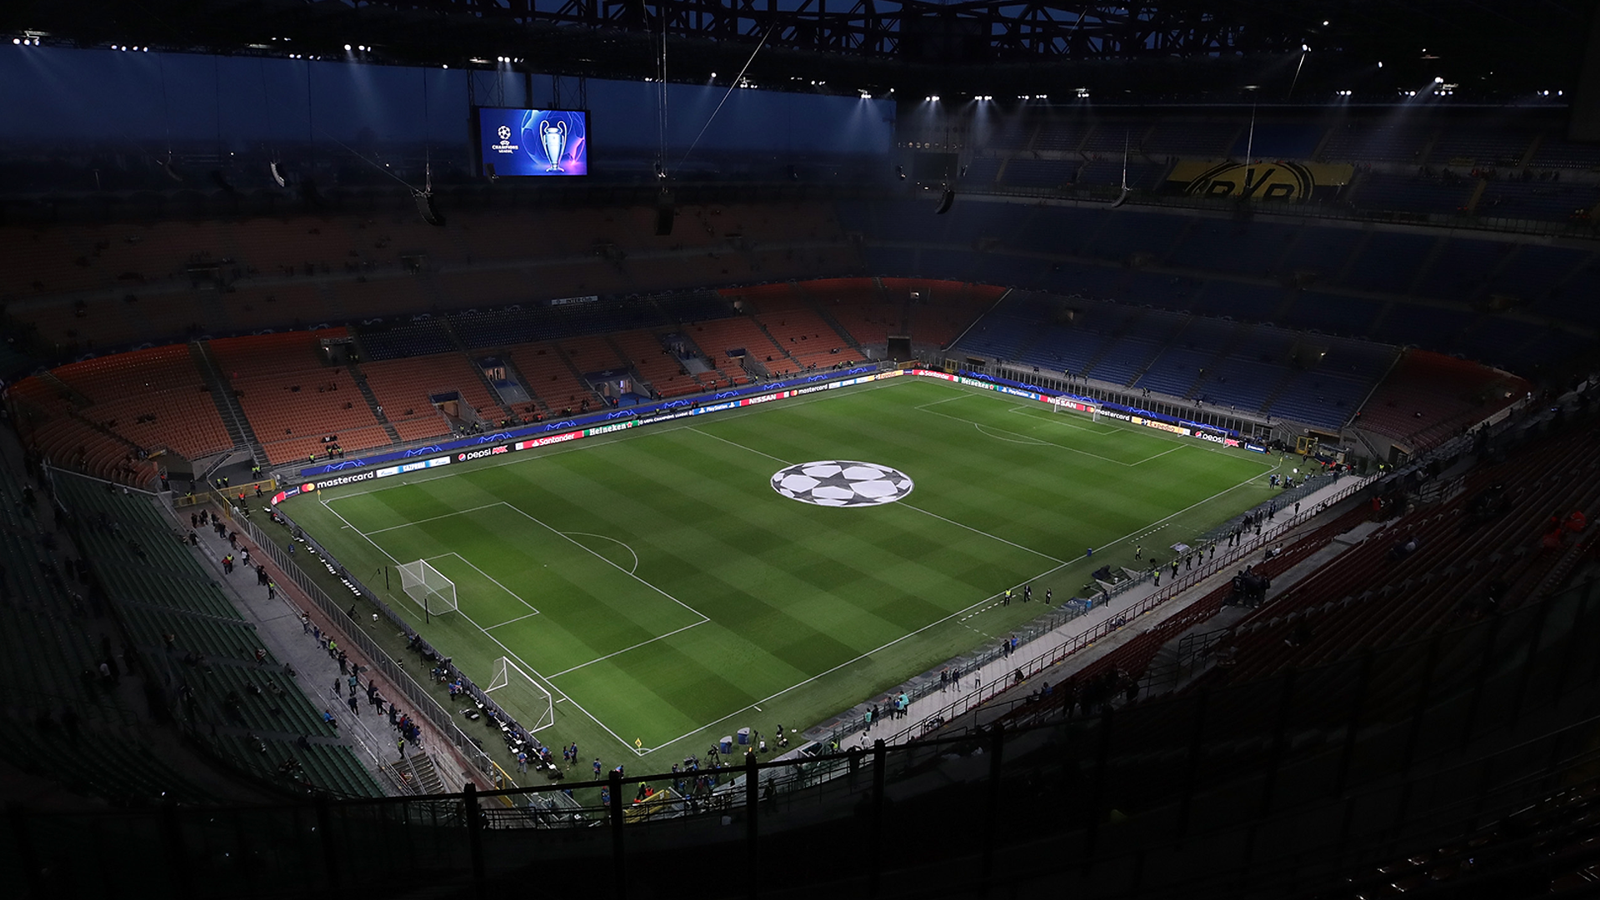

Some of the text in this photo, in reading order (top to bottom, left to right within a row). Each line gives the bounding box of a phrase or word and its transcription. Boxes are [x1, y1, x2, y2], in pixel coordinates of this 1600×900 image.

[798, 384, 828, 394] mastercard
[749, 394, 776, 404] NISSAN
[1047, 398, 1076, 408] NISSAN
[1096, 409, 1130, 420] mastercard
[589, 422, 626, 436] Heineken
[539, 433, 574, 446] Santander
[467, 448, 491, 460] pepsi
[317, 471, 374, 488] mastercard
